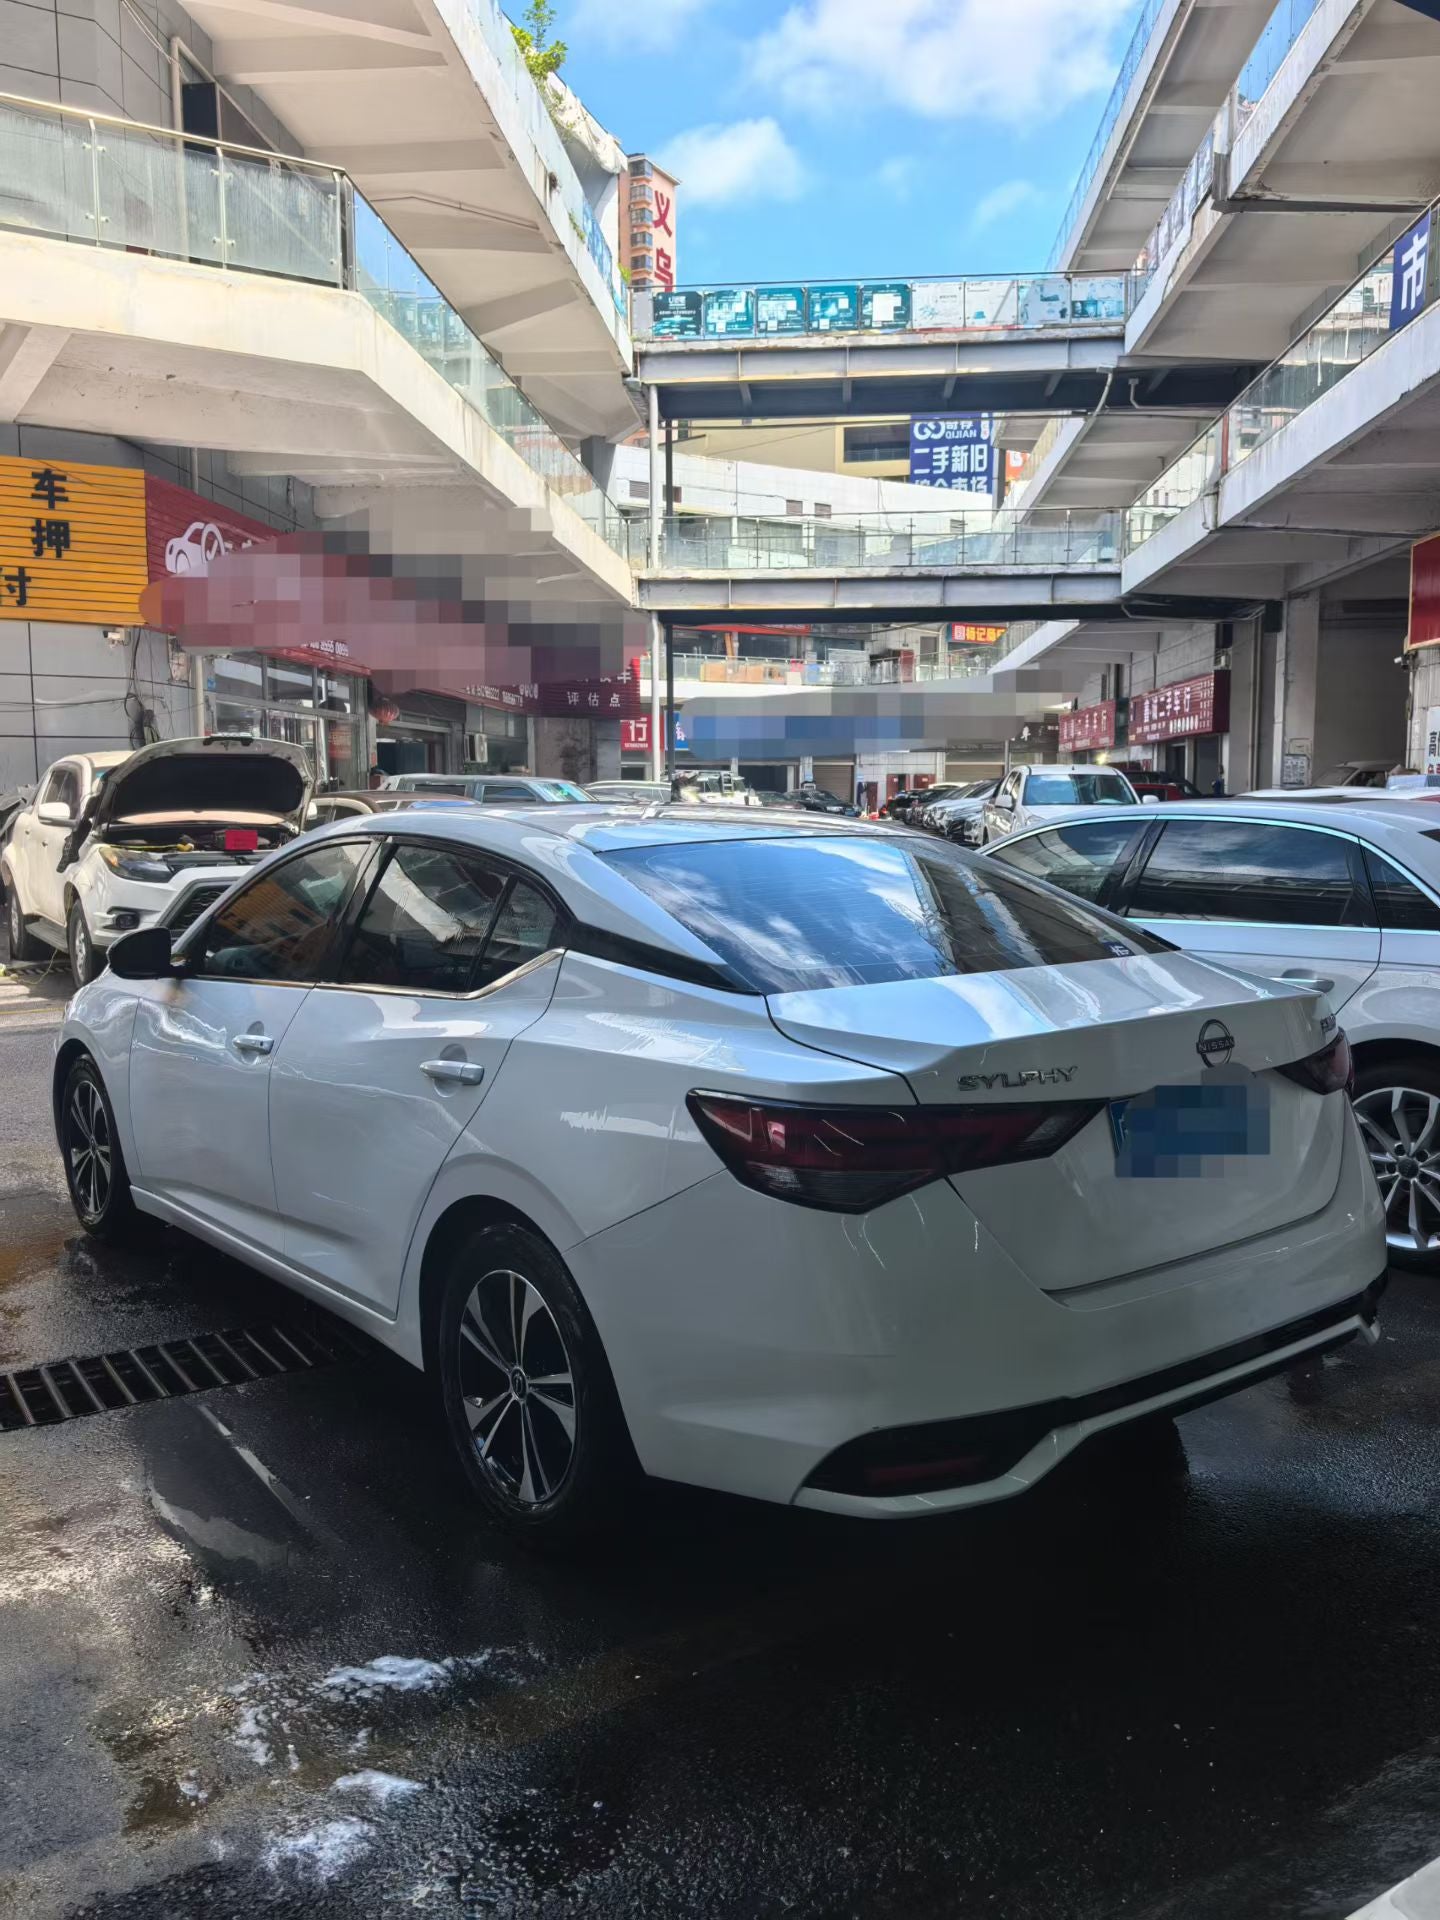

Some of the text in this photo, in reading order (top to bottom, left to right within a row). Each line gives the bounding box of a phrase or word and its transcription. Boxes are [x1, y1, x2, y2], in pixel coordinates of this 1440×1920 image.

[1401, 232, 1428, 311] 市
[945, 429, 977, 439] QIJIAN
[914, 443, 988, 475] 二手新旧
[31, 468, 69, 510] 车
[31, 519, 70, 558] 押
[567, 691, 620, 707] 评估点
[1144, 686, 1190, 723] 二手车行
[957, 1066, 1078, 1091] SYLPHY
